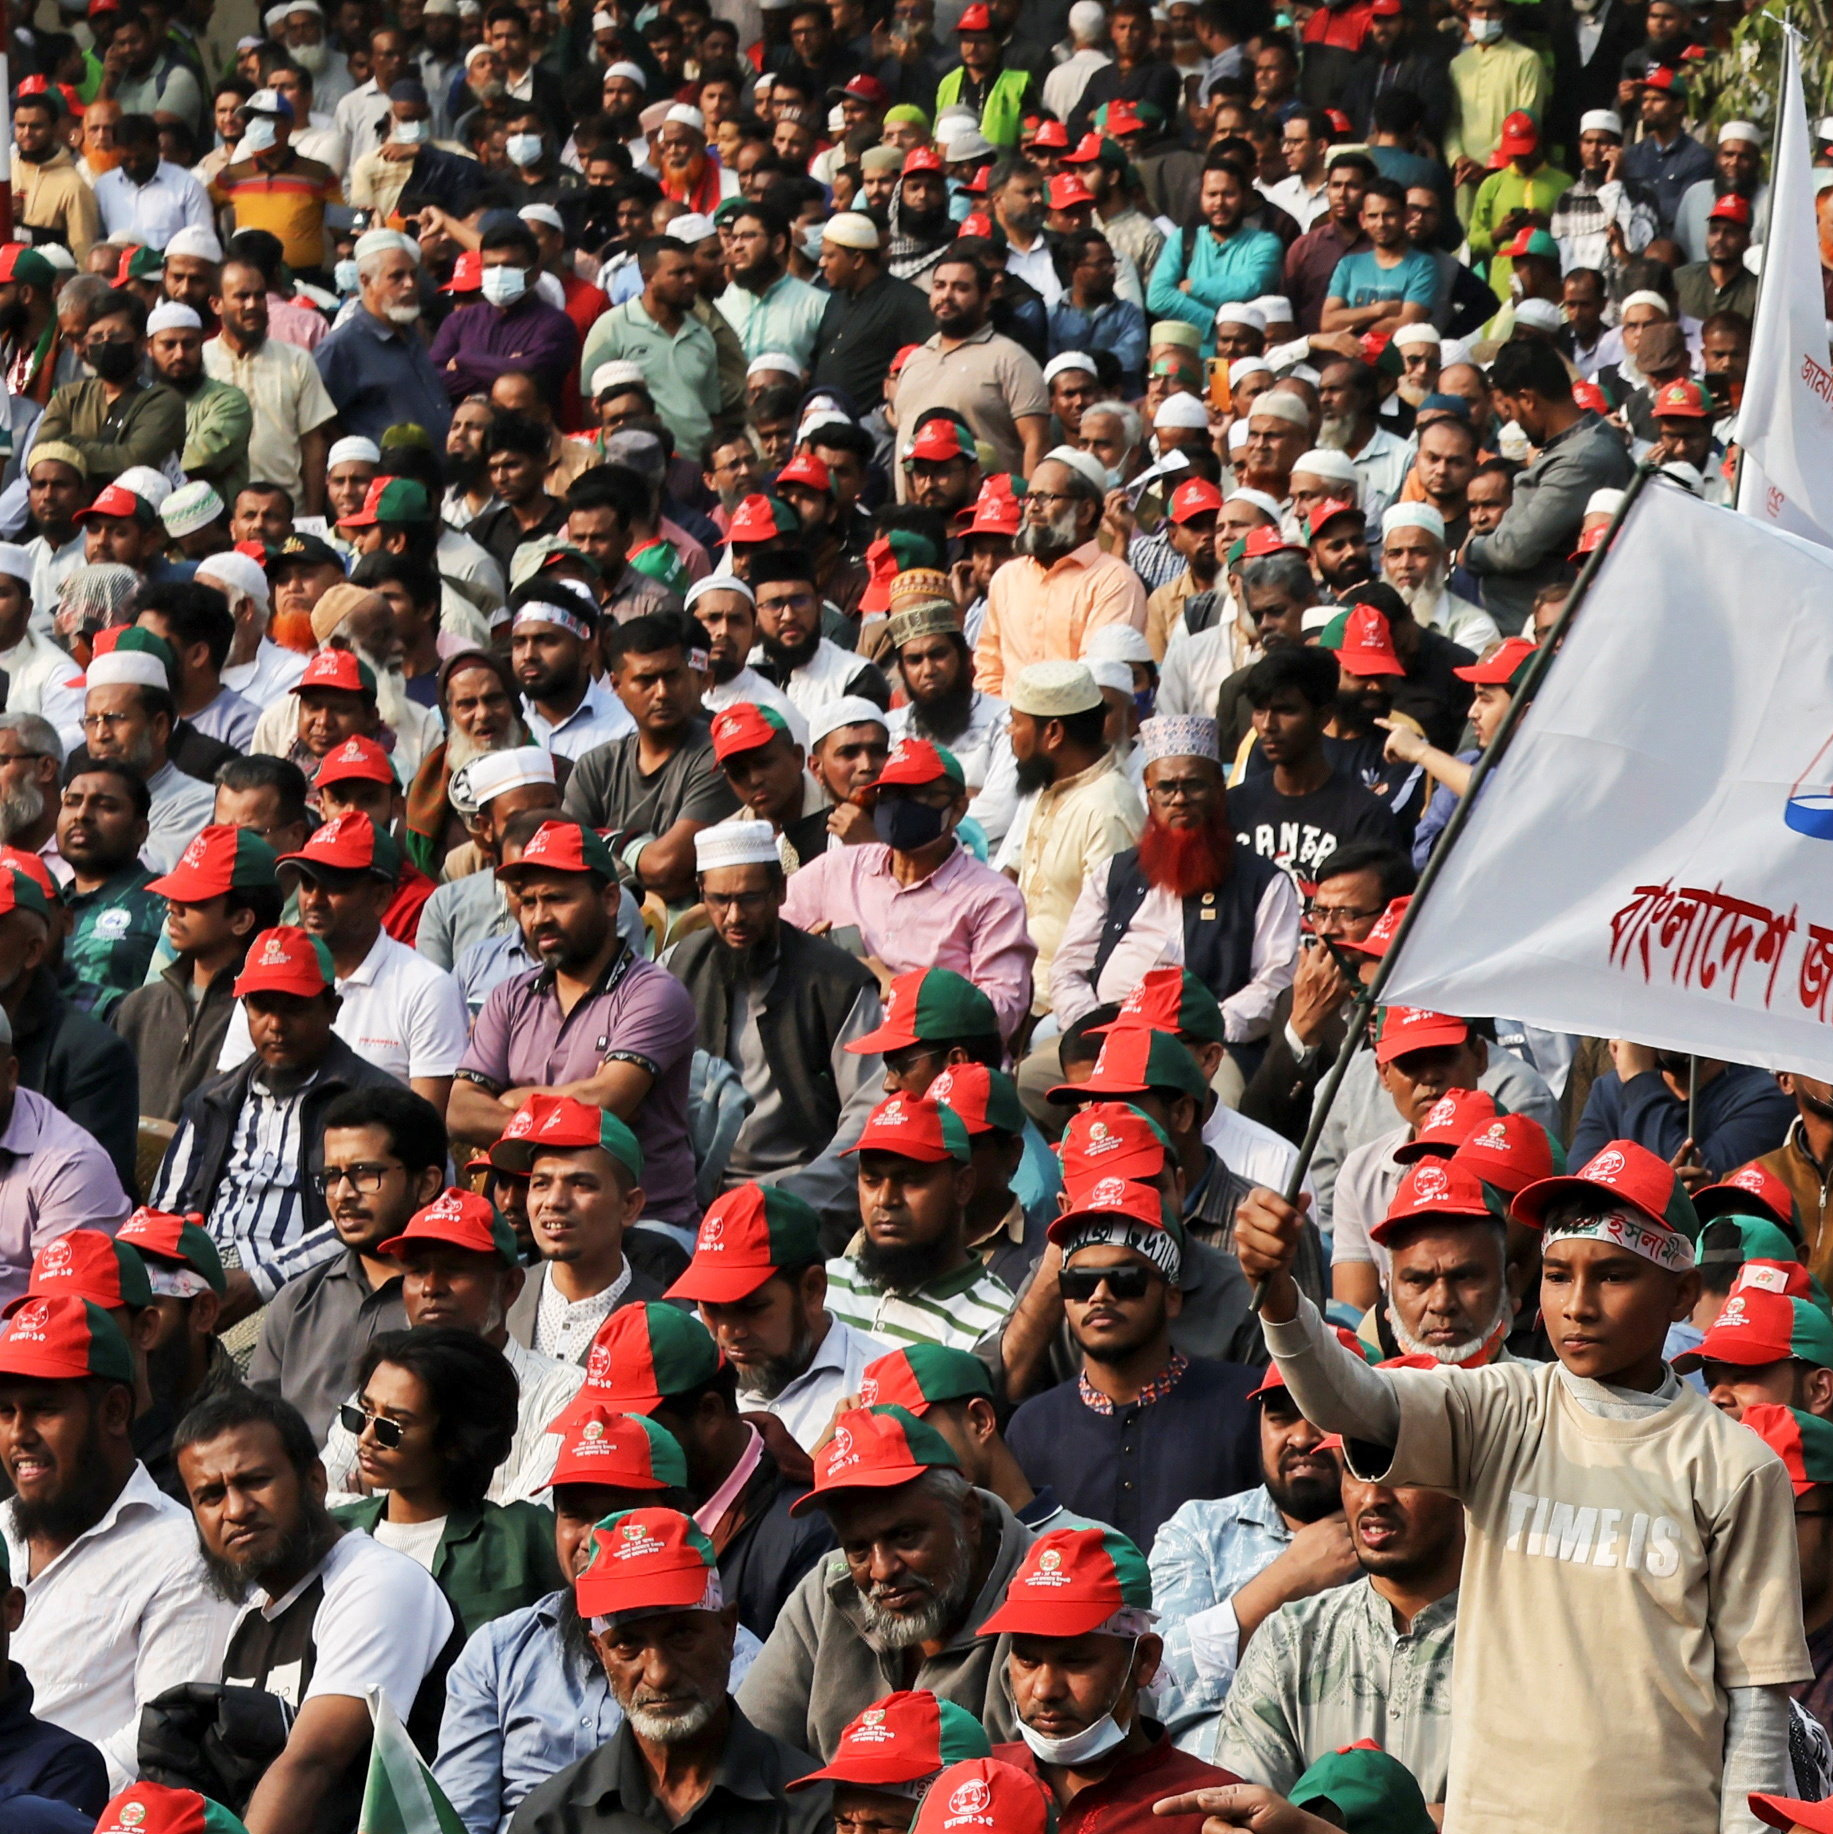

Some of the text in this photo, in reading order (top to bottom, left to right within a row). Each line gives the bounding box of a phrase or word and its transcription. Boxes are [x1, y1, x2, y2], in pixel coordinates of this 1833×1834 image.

[1610, 882, 1800, 1008] বাংলাদেশ
[1609, 1213, 1680, 1267] ইসলামী
[39, 1269, 72, 1281] ঢাকা-১৫
[9, 1332, 46, 1342] ঢাকা-১৫
[1503, 1492, 1681, 1578] TIME IS
[943, 1814, 994, 1829] ঢাকা-১৫
